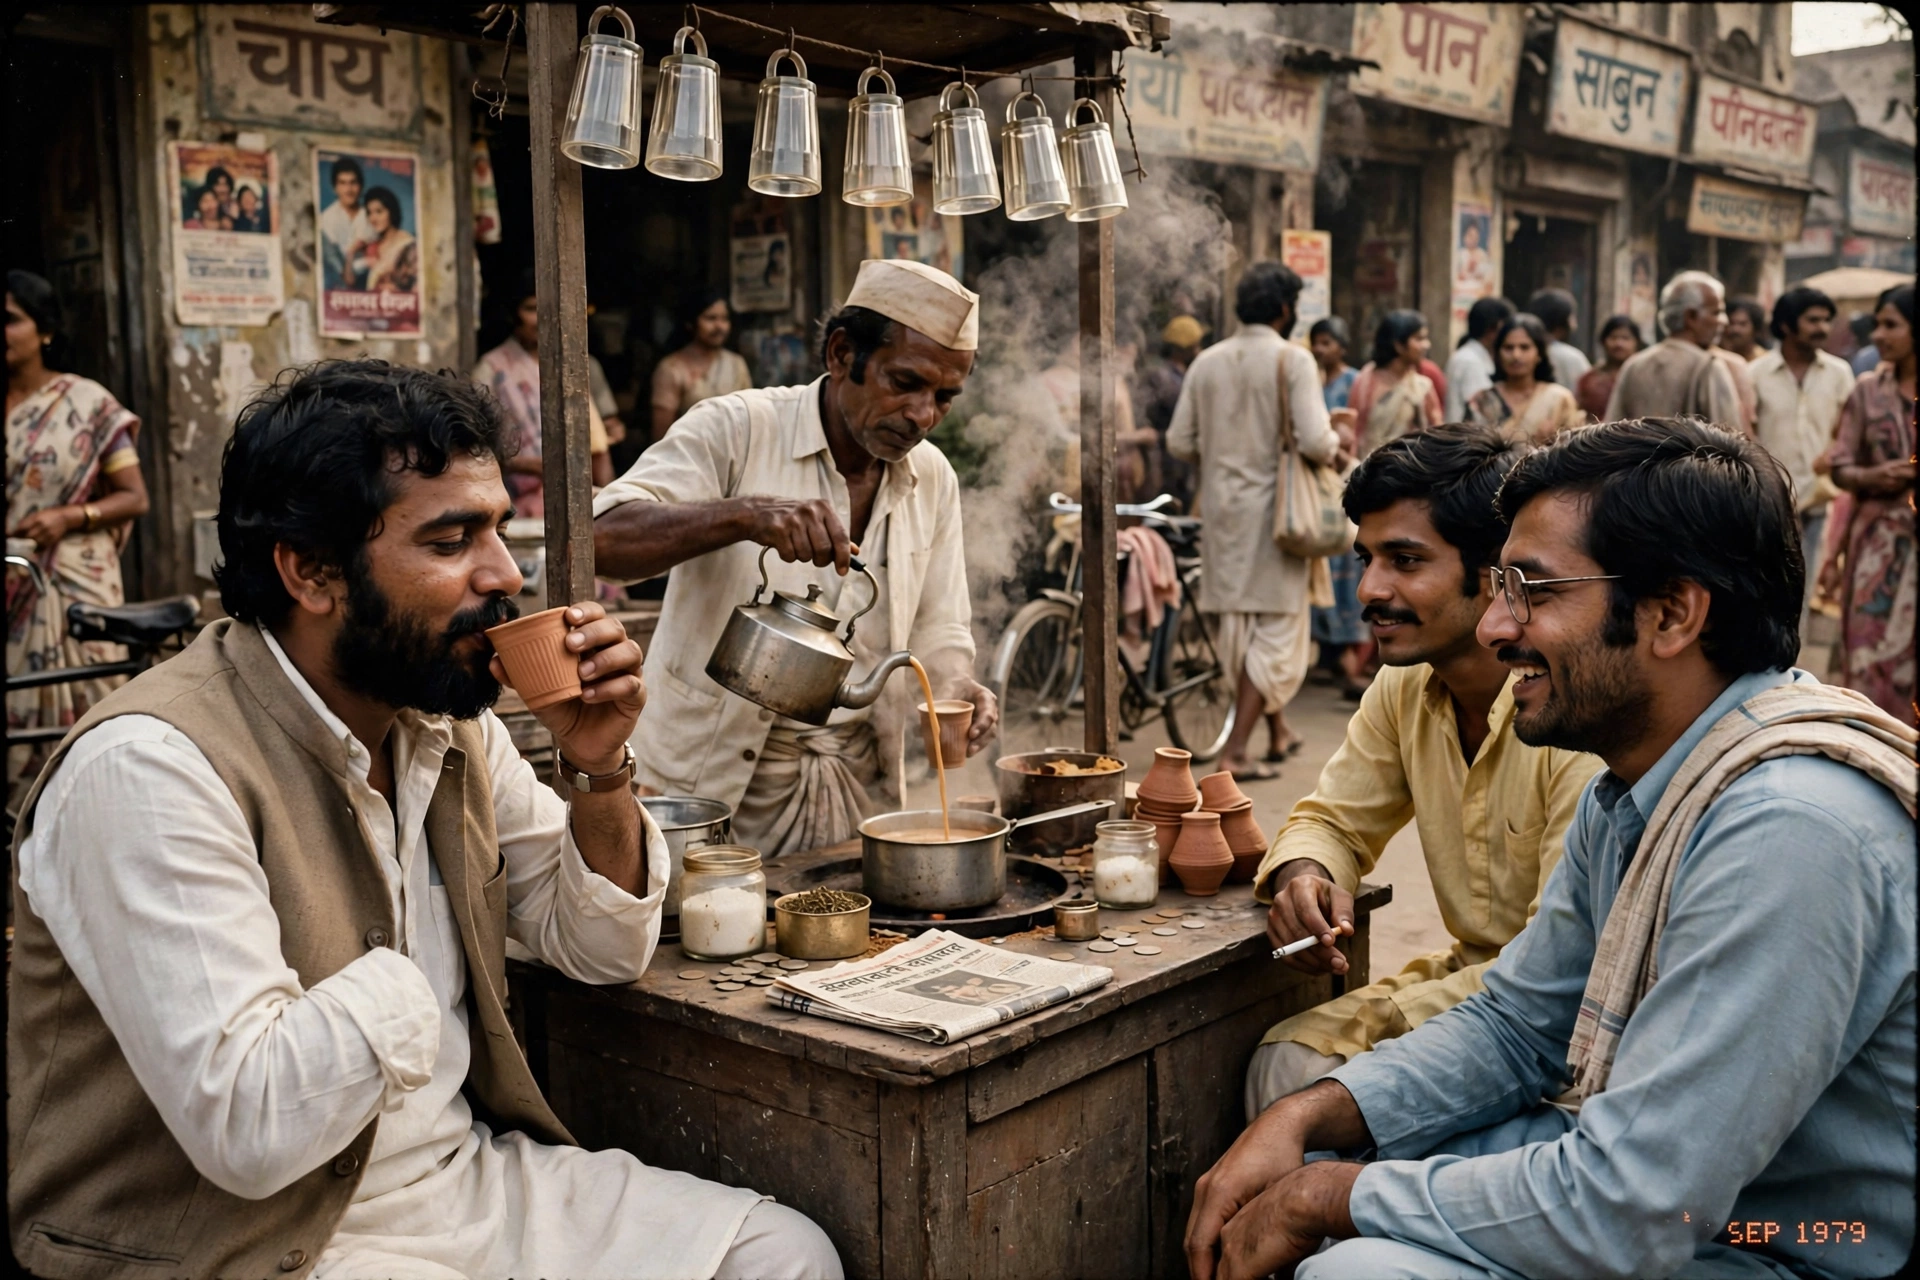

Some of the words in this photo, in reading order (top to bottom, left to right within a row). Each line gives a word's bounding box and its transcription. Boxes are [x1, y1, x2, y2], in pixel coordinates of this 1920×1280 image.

[233, 18, 392, 109] चाय
[1400, 3, 1488, 86] पान
[1574, 48, 1662, 134] साबुन
